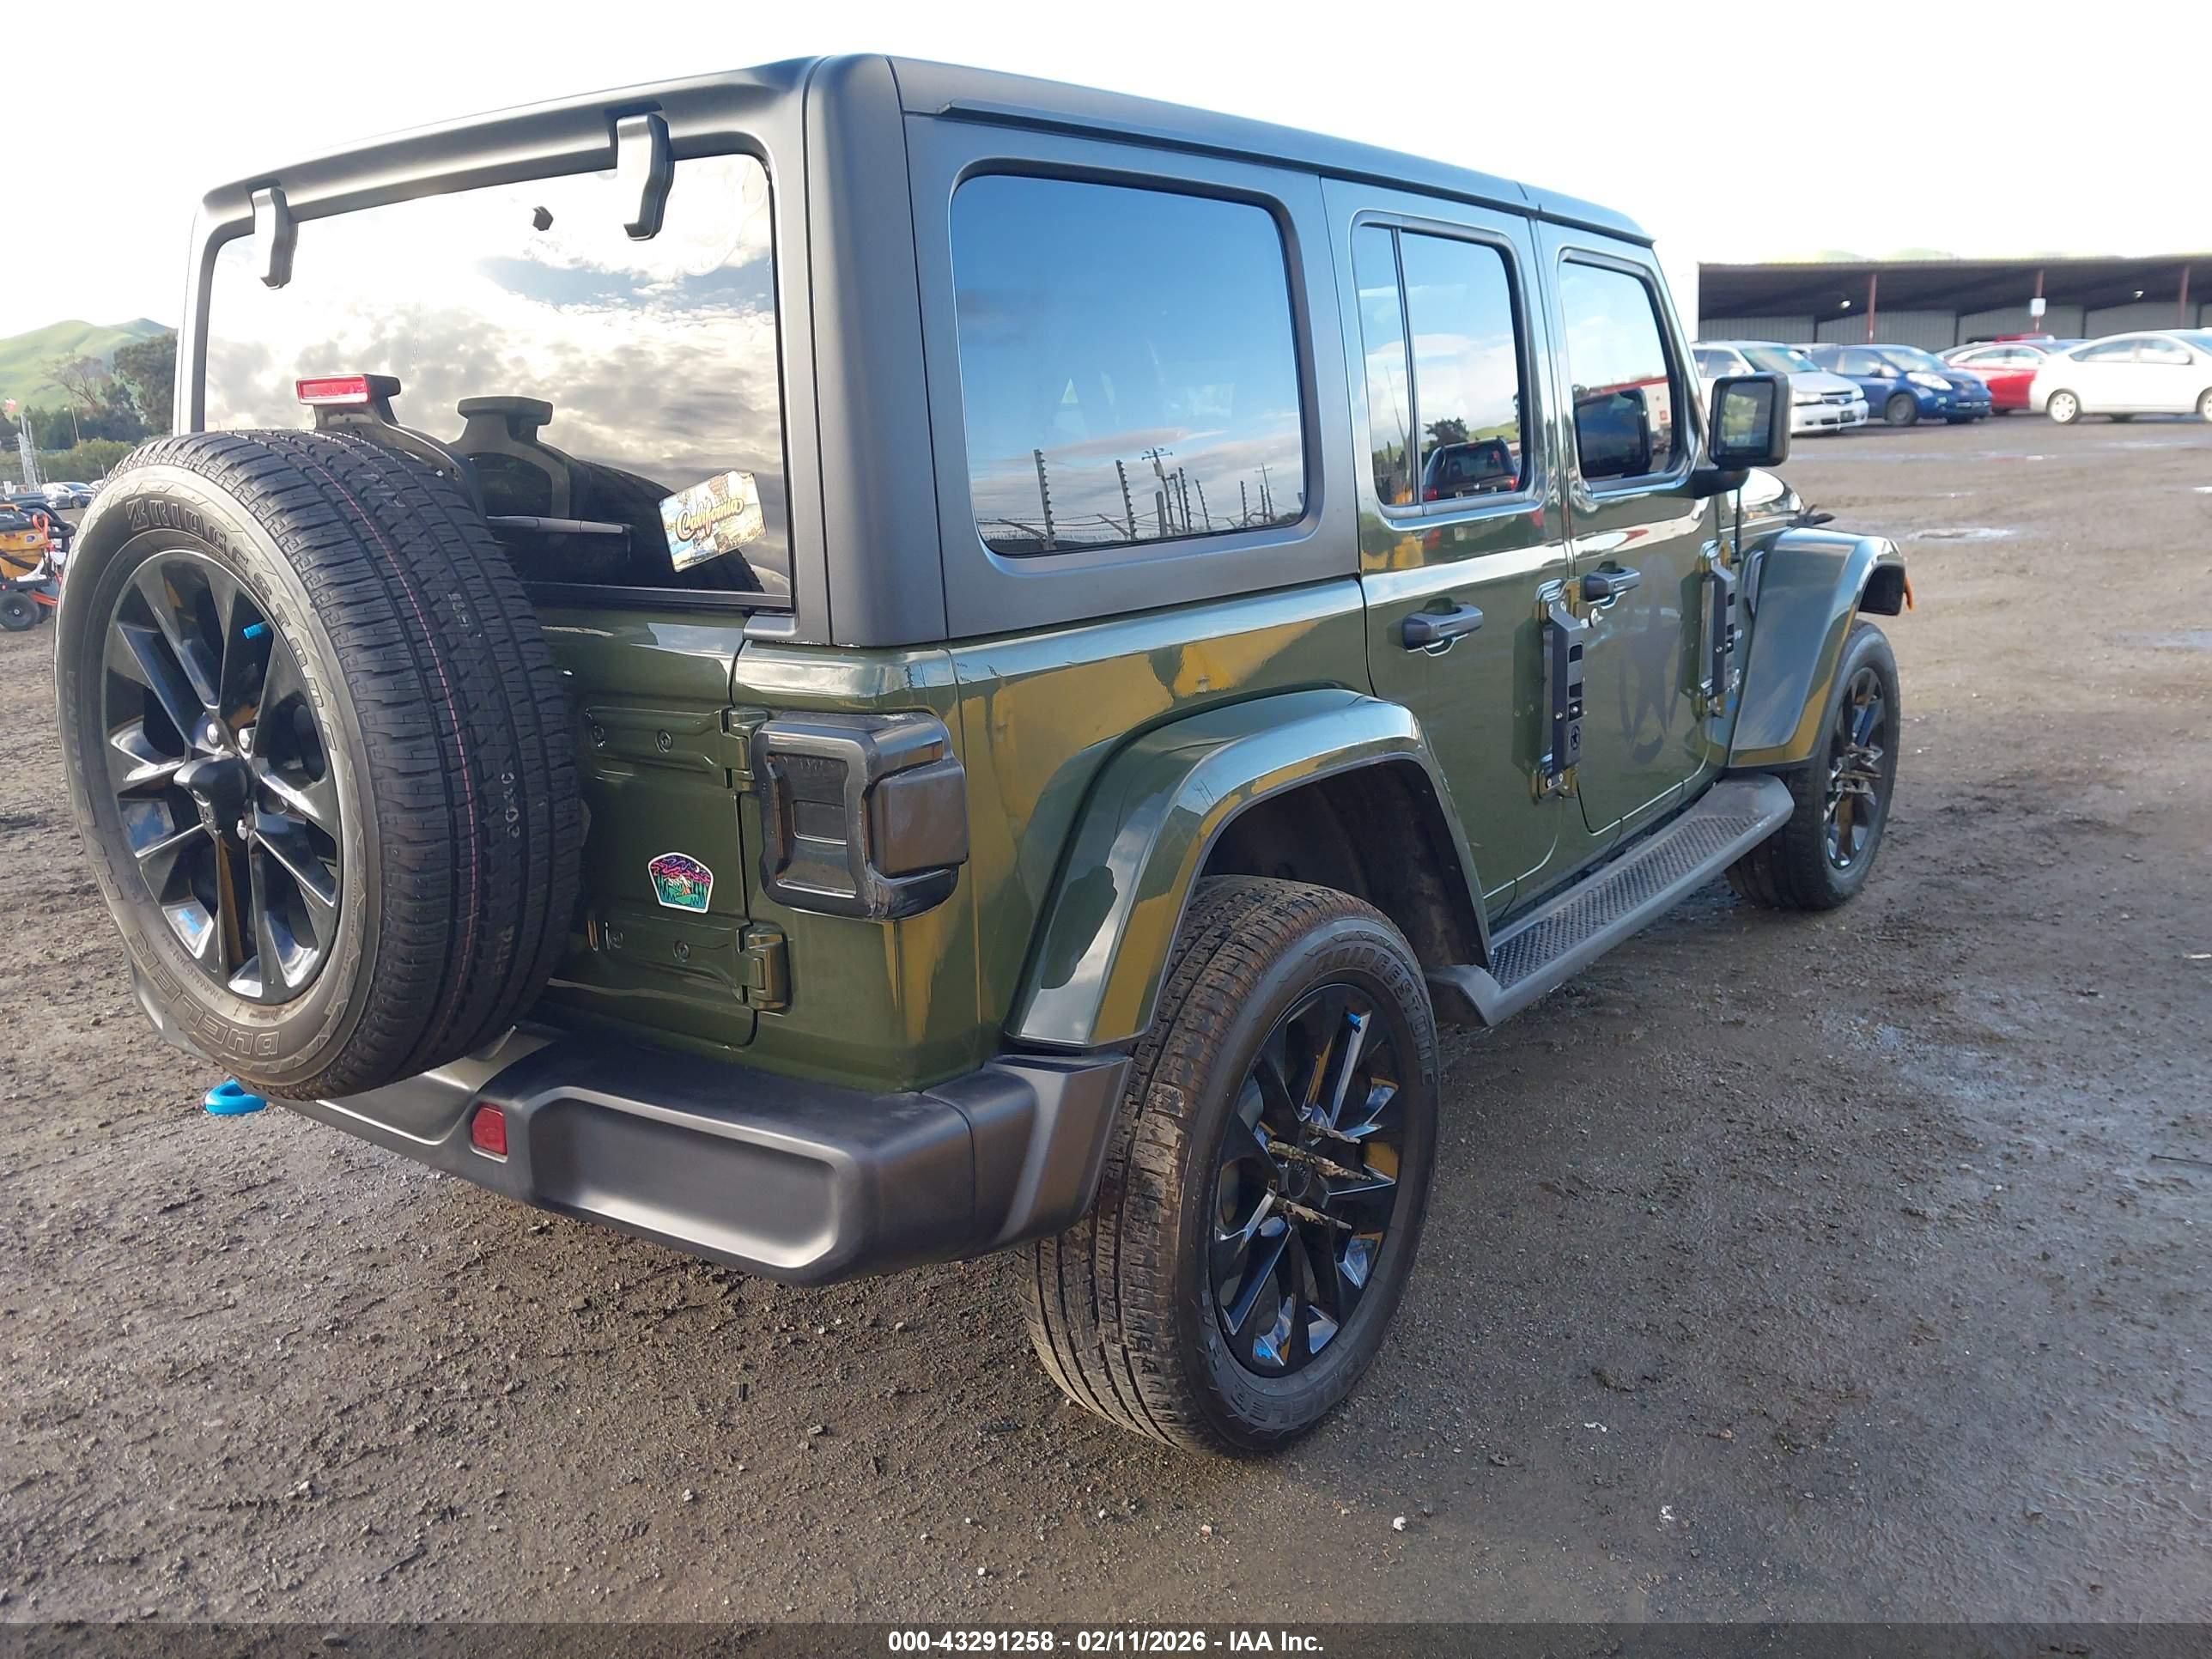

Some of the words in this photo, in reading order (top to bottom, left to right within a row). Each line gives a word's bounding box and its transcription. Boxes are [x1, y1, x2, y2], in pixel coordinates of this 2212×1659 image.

[676, 496, 744, 543] California
[126, 497, 337, 750] BRIDGESTONE
[129, 931, 280, 1056] DUELER
[1313, 945, 1435, 1085] BRIDGESTONE
